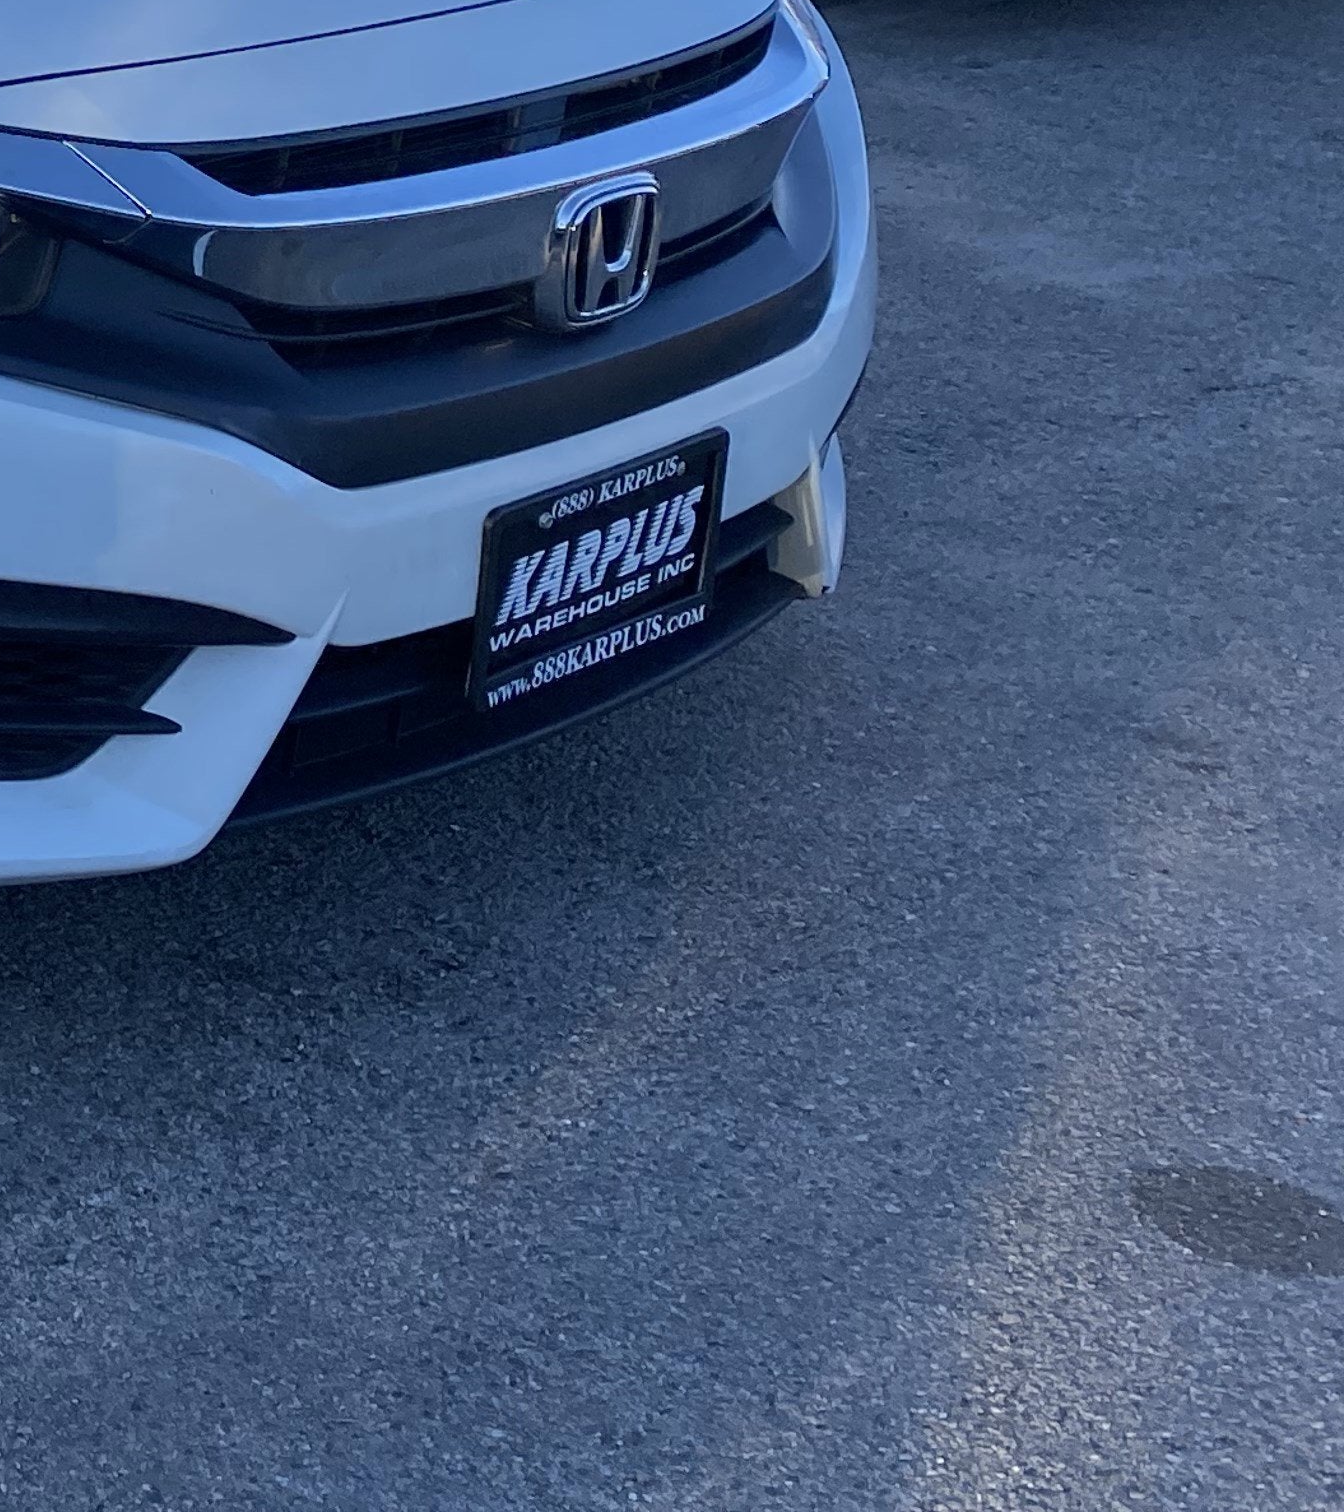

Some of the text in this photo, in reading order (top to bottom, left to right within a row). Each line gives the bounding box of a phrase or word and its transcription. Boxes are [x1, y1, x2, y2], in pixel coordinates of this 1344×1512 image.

[552, 455, 680, 519] (888) KARPLUS
[489, 552, 695, 652] WAREHOUSE INC
[492, 484, 705, 627] KARPLUS
